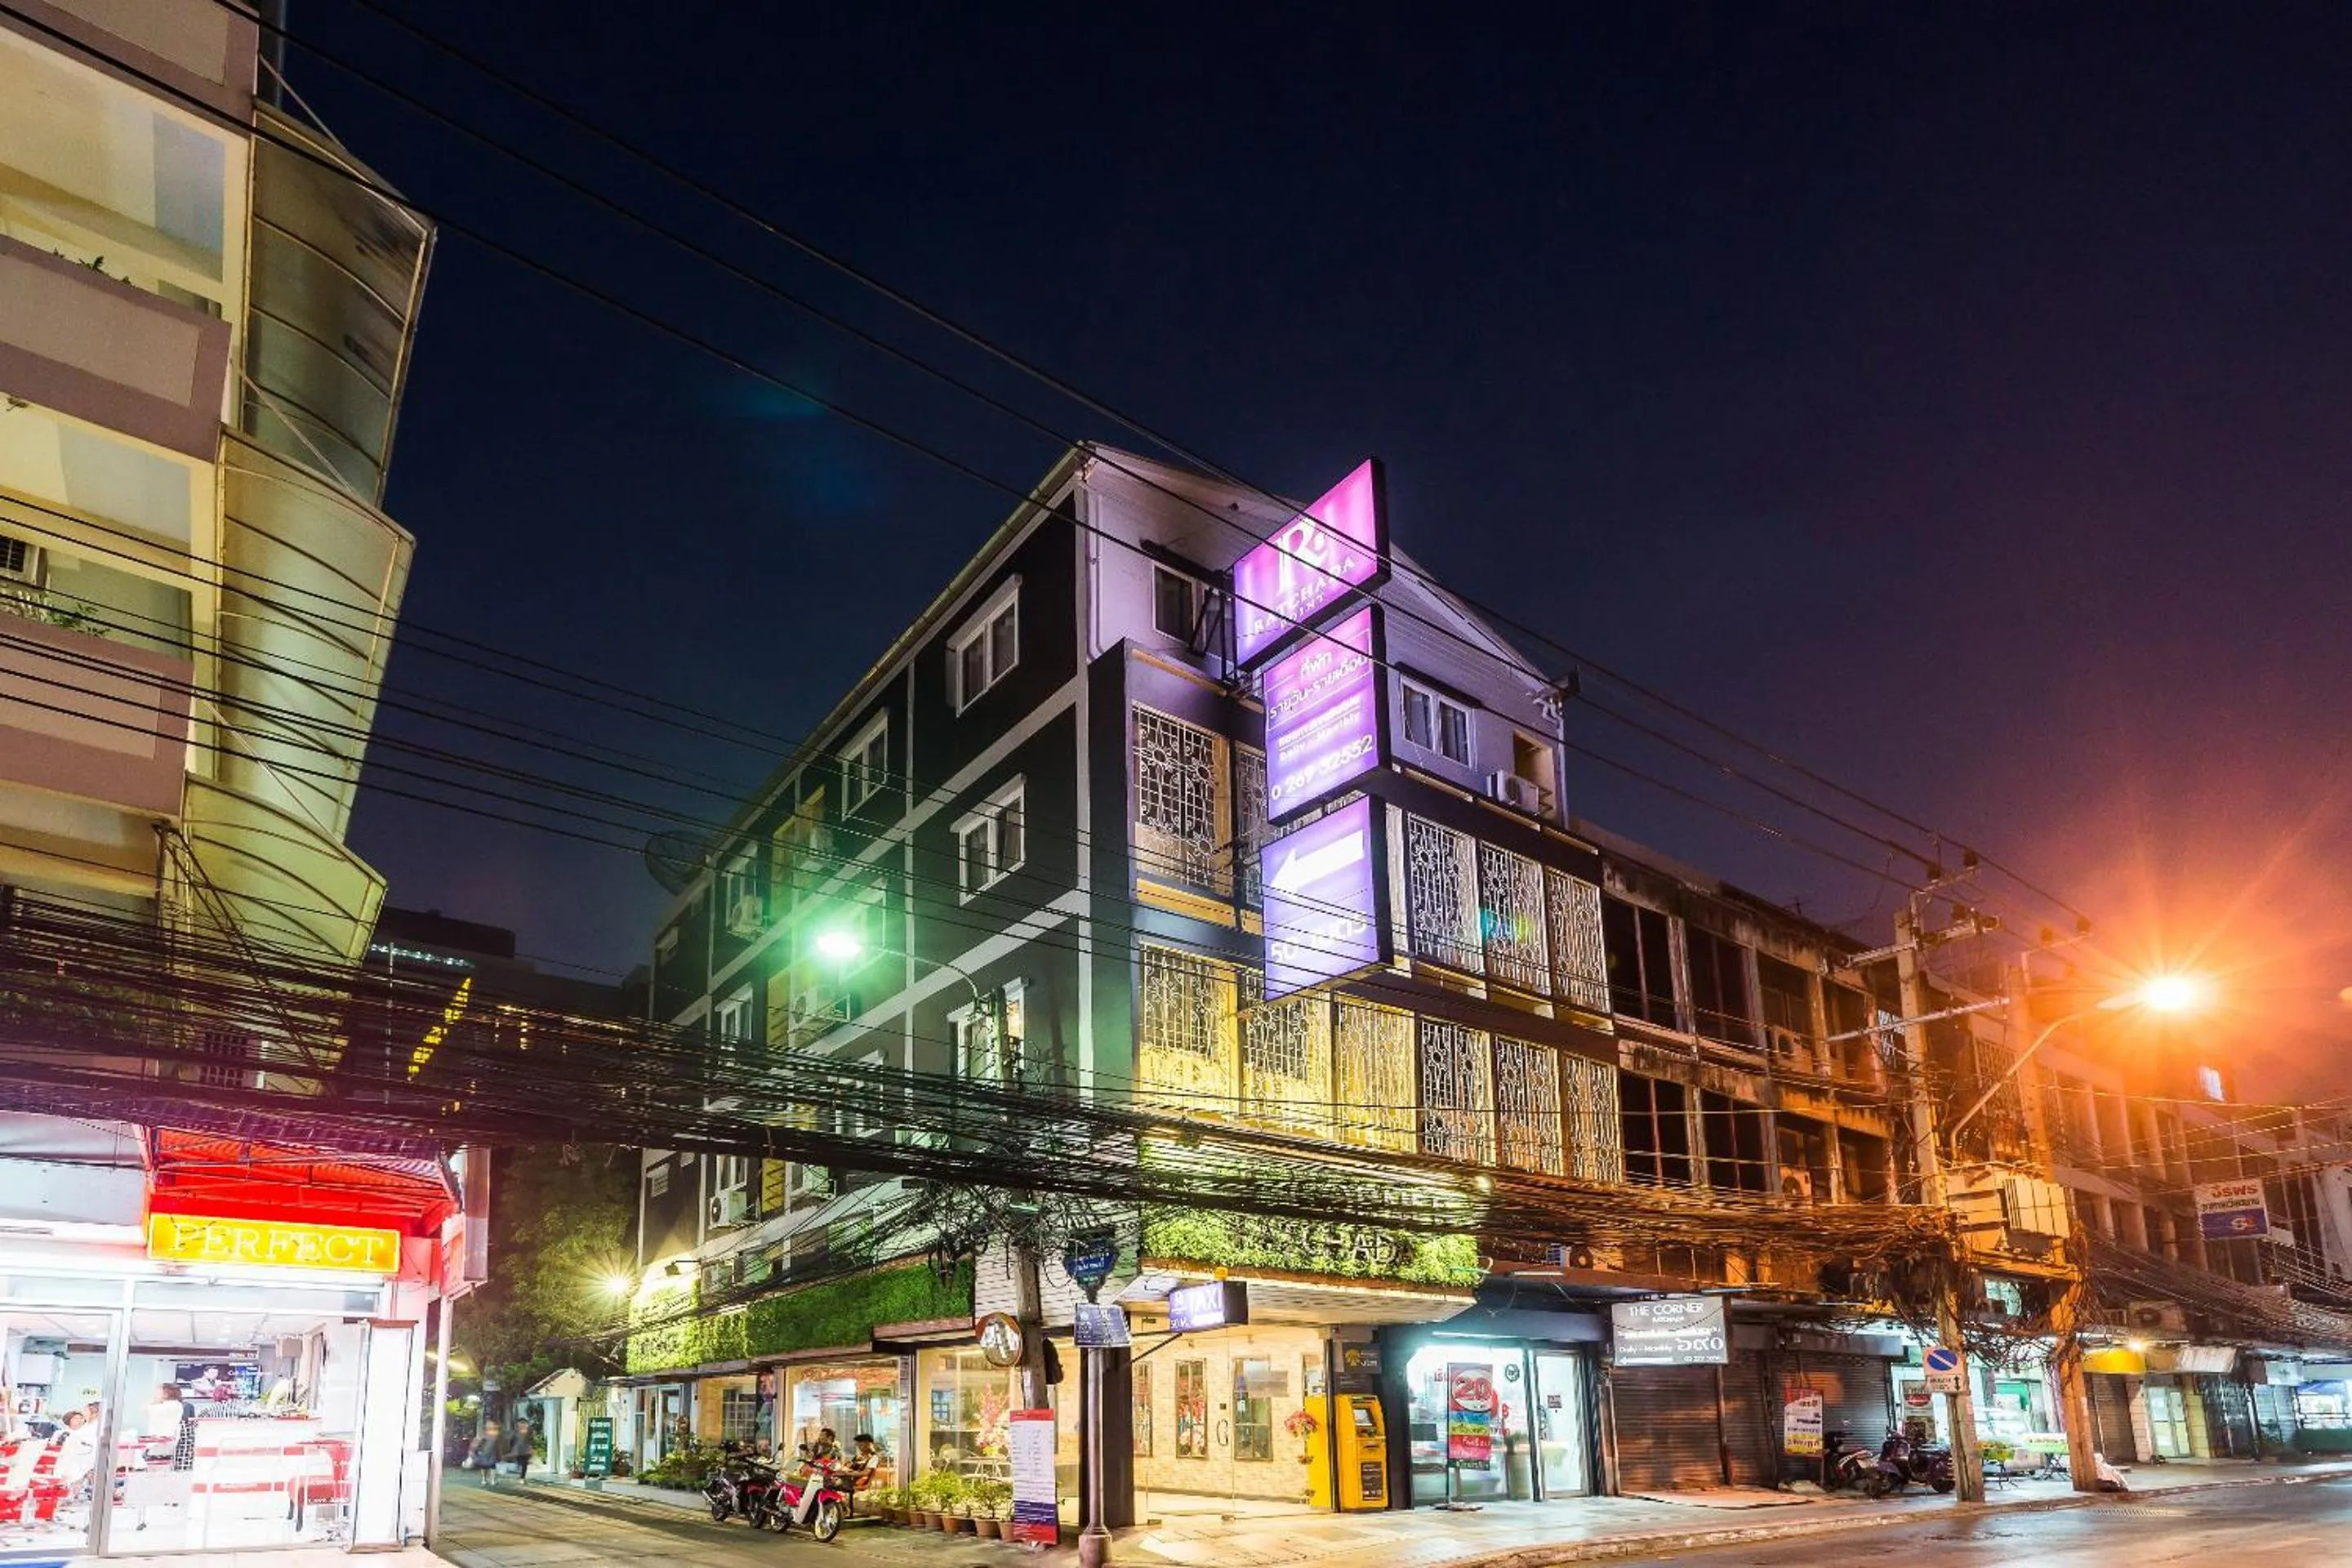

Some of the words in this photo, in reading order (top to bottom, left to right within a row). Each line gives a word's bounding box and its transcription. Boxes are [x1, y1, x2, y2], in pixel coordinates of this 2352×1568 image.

[172, 1223, 384, 1263] PERFECT
[1187, 1288, 1223, 1312] TAXI
[1628, 1305, 1650, 1316] THE
[1653, 1303, 1704, 1315] CORNER
